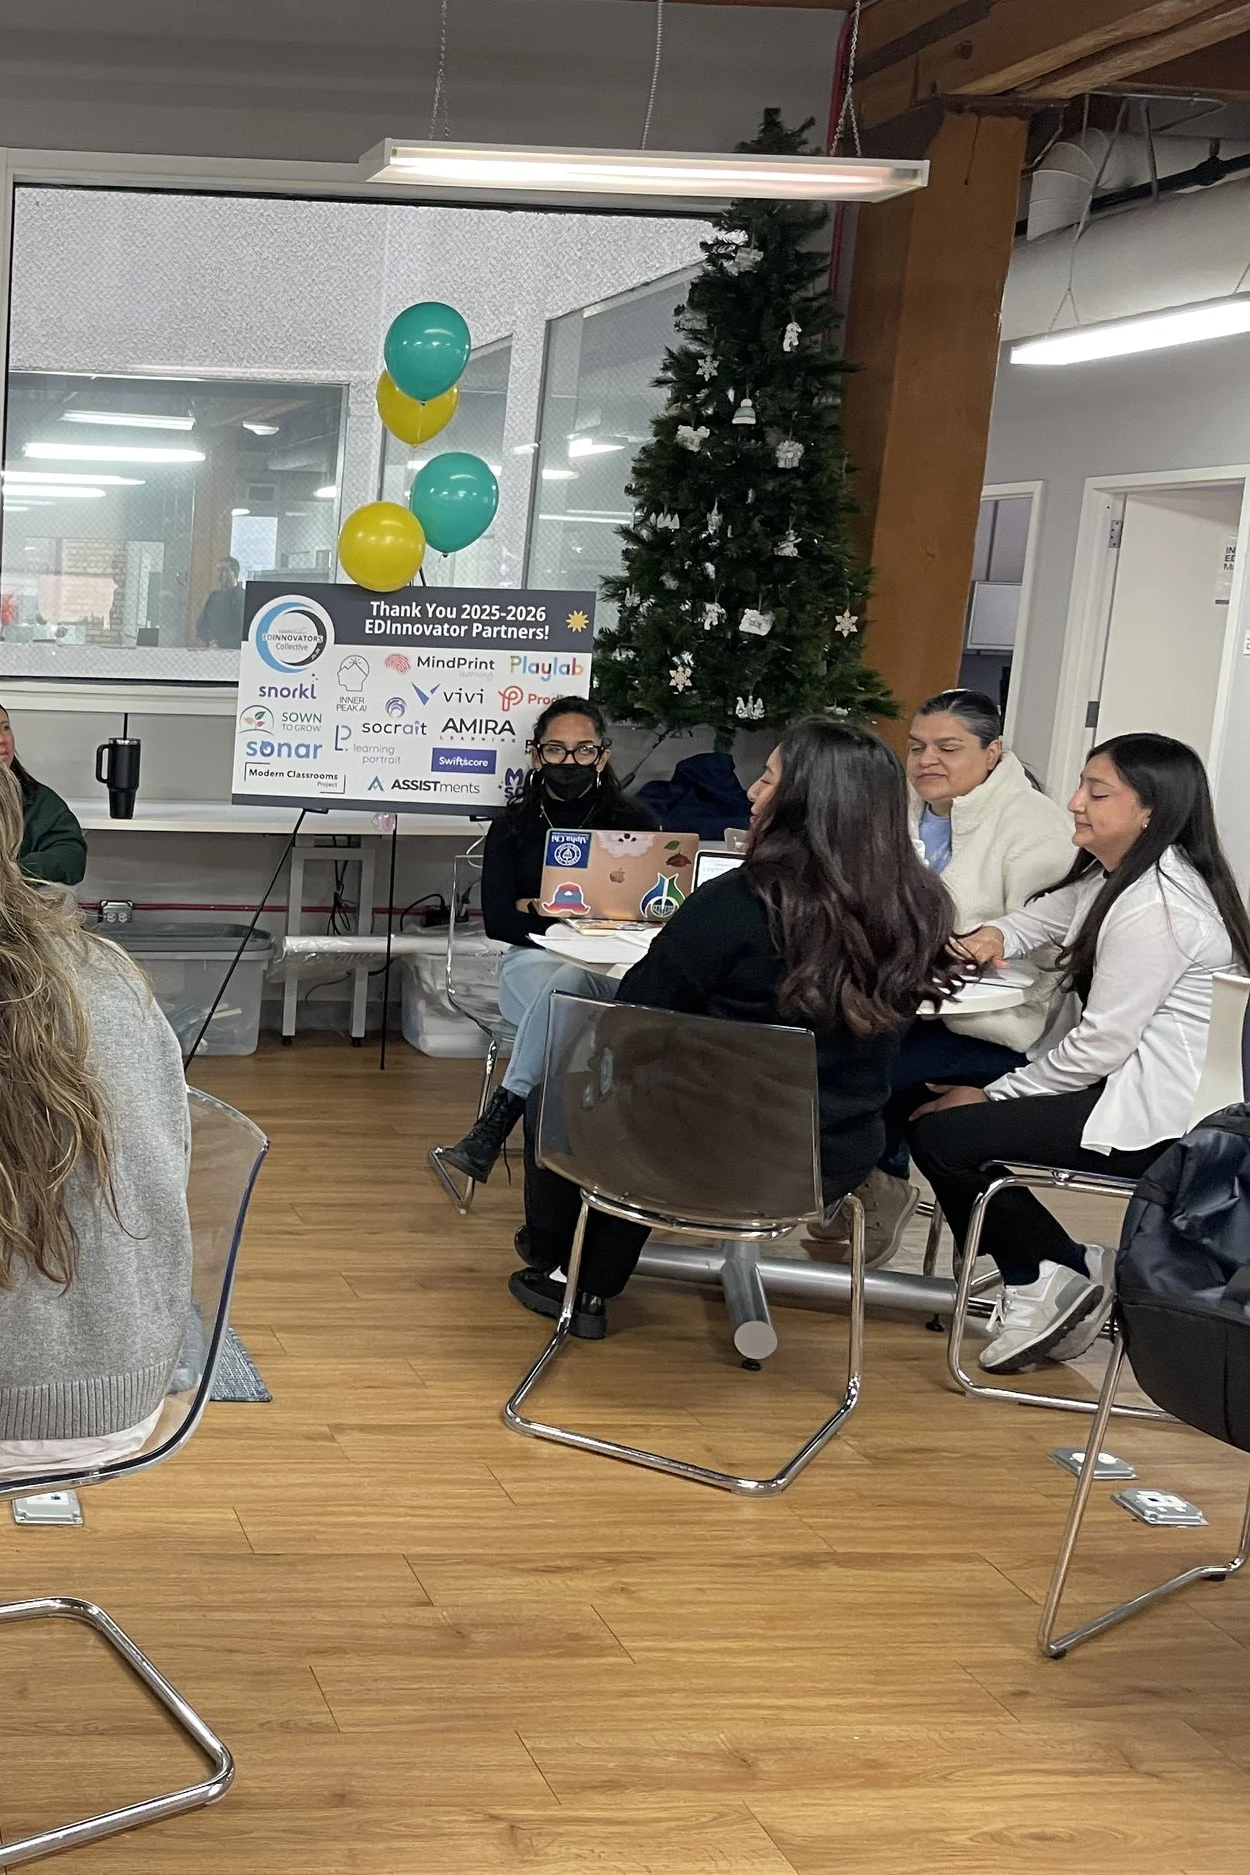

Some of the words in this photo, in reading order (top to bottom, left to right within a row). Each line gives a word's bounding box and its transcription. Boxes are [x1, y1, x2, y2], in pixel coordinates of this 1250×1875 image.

[370, 600, 422, 618] Thank
[425, 603, 457, 619] You
[460, 604, 547, 622] 2025-2026
[364, 619, 469, 637] EDInnovator
[472, 622, 550, 640] Partners!
[417, 655, 495, 671] MindPrint
[509, 655, 584, 682] Playlab
[258, 683, 317, 700] snorkl
[443, 688, 484, 704] vivi
[340, 696, 364, 704] INNER
[281, 712, 322, 723] SOWN
[282, 724, 293, 732] TO
[294, 724, 322, 732] GROW
[362, 720, 427, 735] socrait
[441, 717, 516, 736] AMIRA
[440, 735, 516, 743] LEARNING
[245, 740, 323, 759] sonar
[353, 744, 395, 755] learning
[362, 755, 401, 765] portrait
[438, 756, 489, 767] Swiftscore
[249, 768, 284, 778] Modern
[287, 770, 338, 780] Classrooms
[317, 781, 338, 789] Project
[391, 779, 481, 794] ASSISTments
